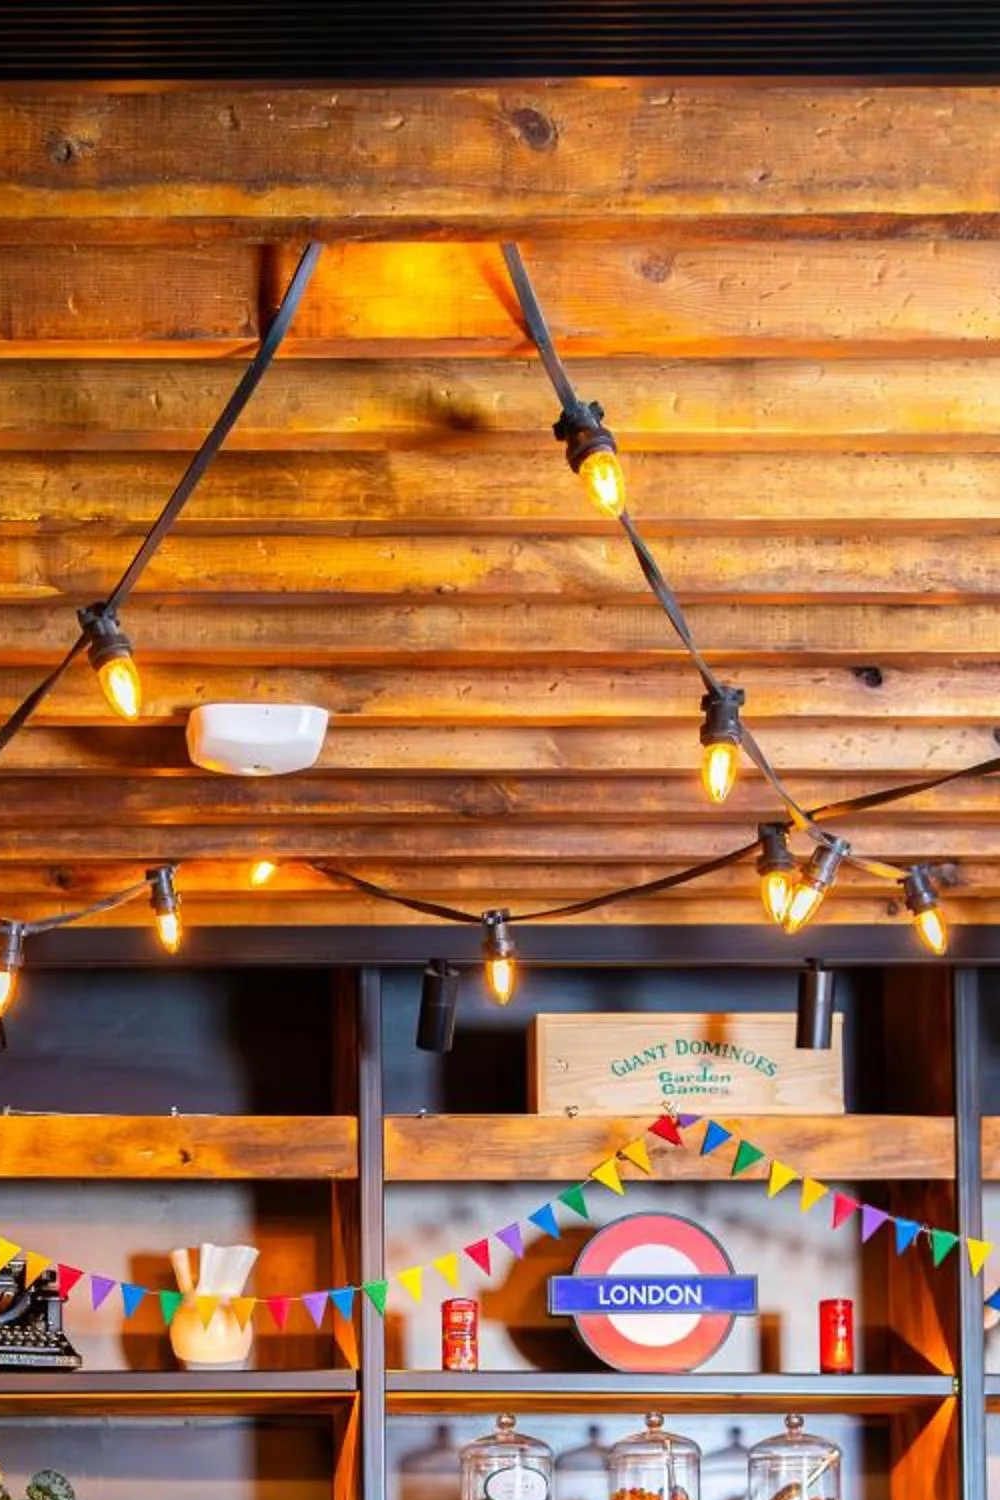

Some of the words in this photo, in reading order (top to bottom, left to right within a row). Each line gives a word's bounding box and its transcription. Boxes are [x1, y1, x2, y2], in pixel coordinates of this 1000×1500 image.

[611, 1044, 667, 1077] GIANT
[674, 1039, 777, 1077] DOMINOES
[658, 1067, 731, 1083] Garden
[661, 1083, 730, 1095] Games
[598, 1284, 703, 1306] LONDON
